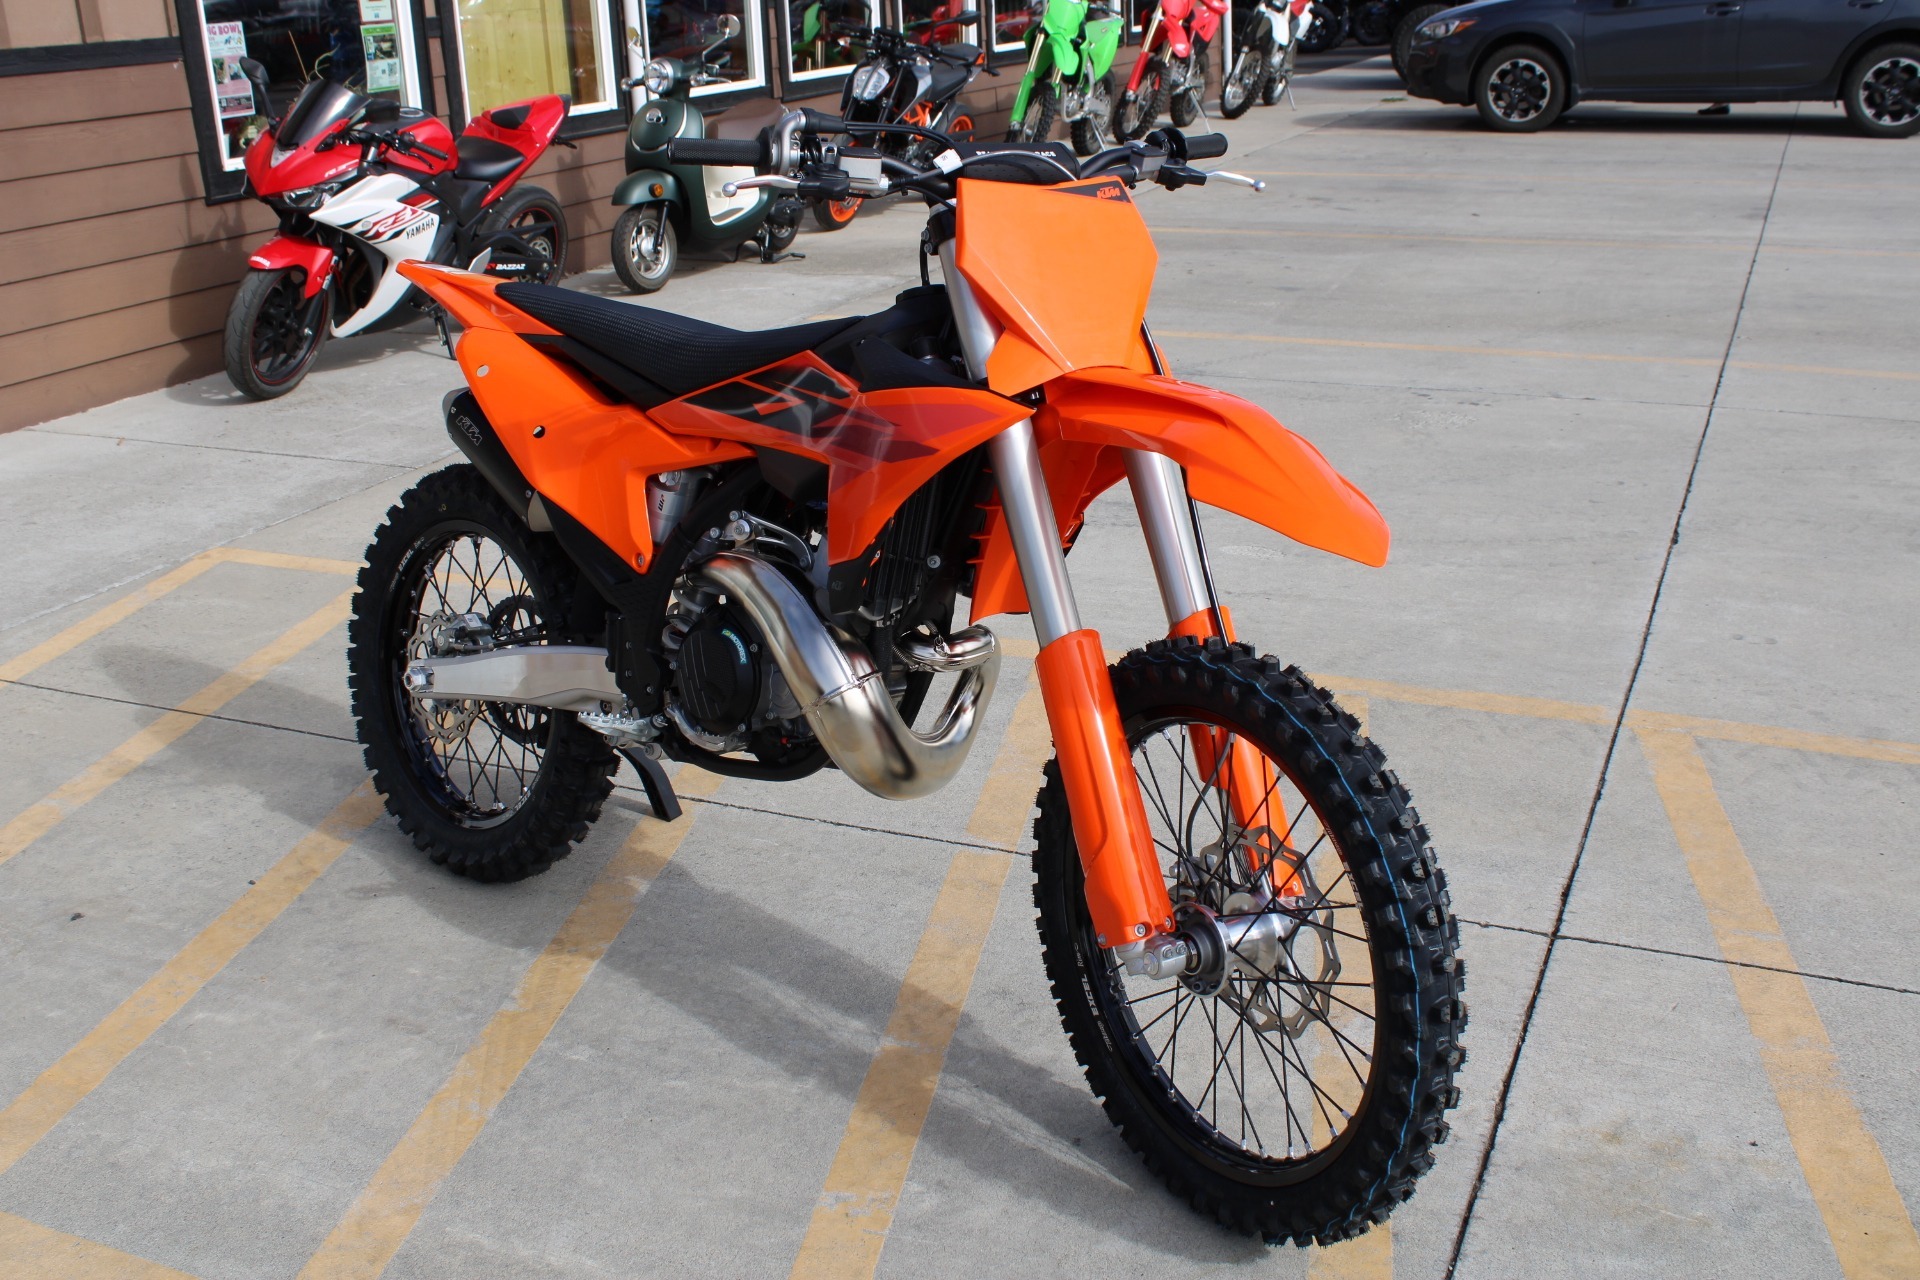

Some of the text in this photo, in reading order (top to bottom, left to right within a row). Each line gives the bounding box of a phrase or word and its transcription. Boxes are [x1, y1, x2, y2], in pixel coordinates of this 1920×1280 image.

[1097, 186, 1121, 199] KTM
[406, 217, 436, 240] YAMAHA
[456, 415, 483, 446] KTM
[730, 633, 747, 664] MOTOREX
[1081, 974, 1099, 1016] EXCEL
